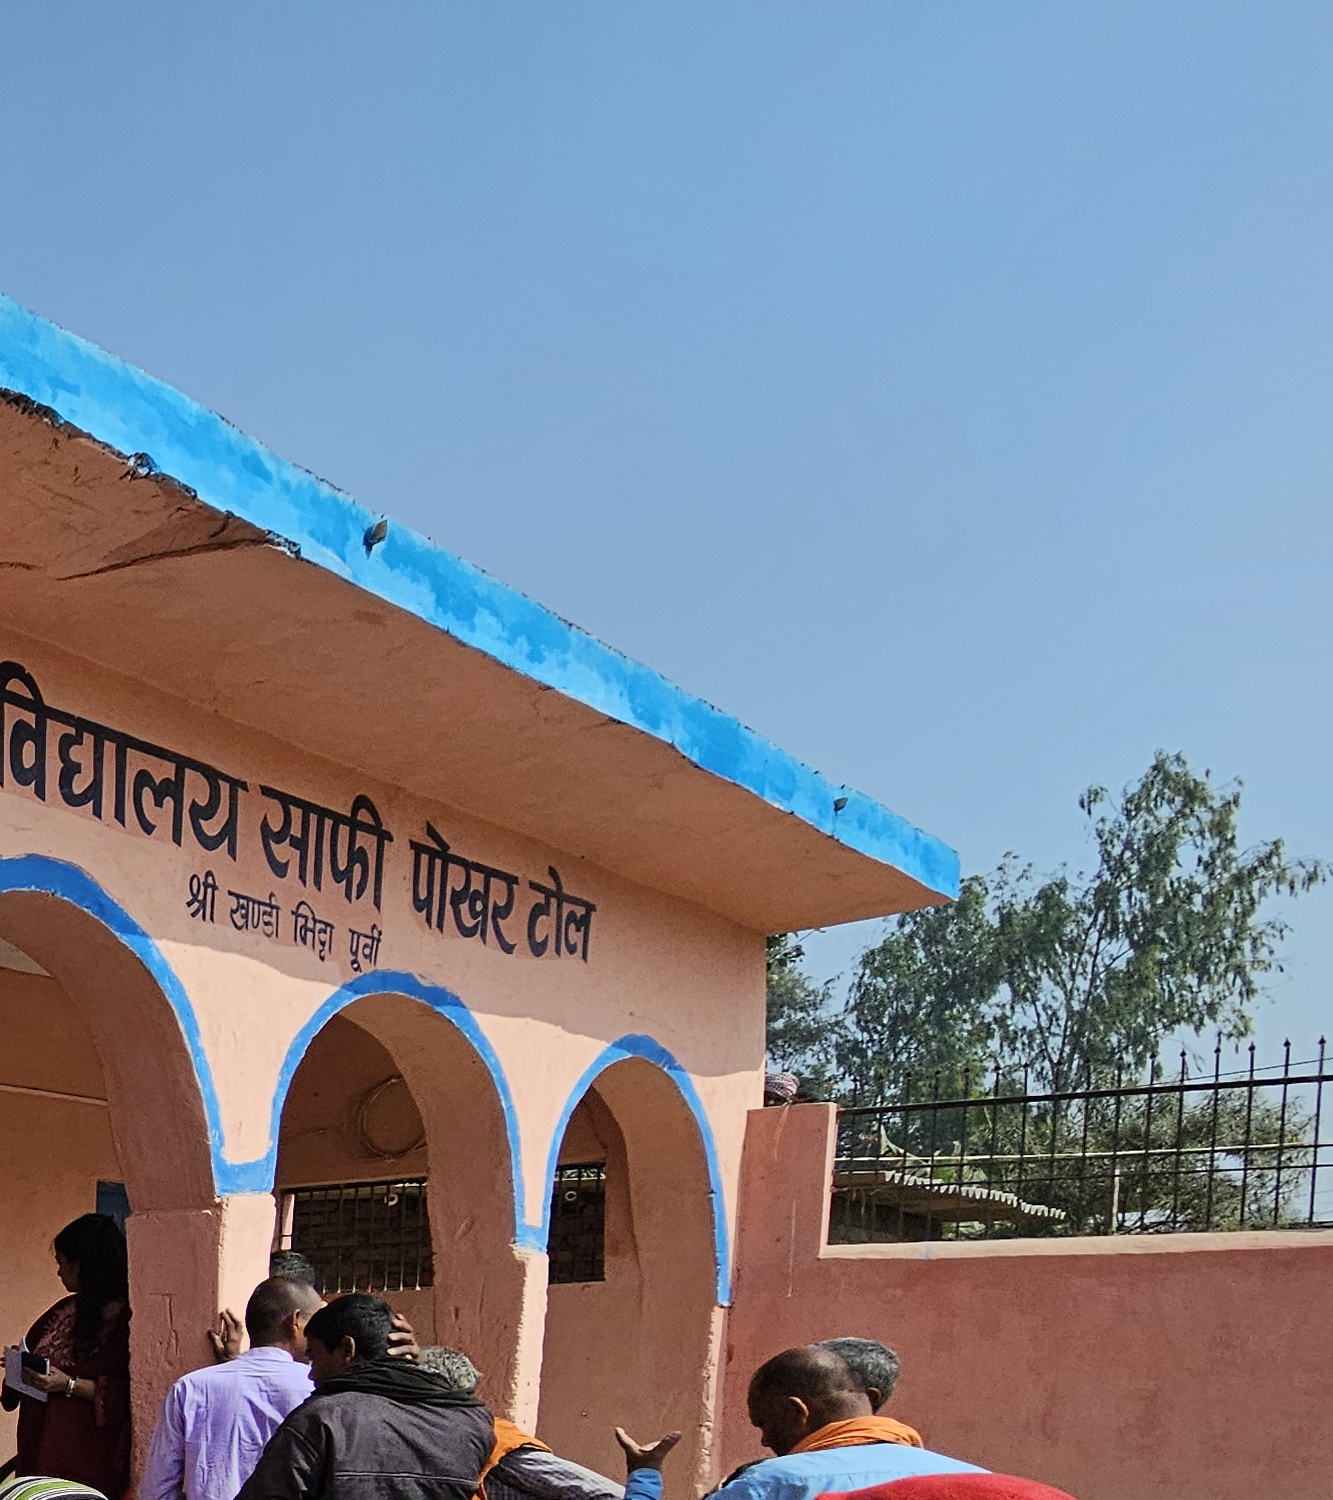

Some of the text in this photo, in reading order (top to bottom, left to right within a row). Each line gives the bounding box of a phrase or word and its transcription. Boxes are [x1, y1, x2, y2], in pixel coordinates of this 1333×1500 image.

[186, 870, 219, 924] श्री
[228, 891, 281, 939] खण्डी
[260, 785, 394, 912] साफी
[409, 821, 519, 954] पोखर
[527, 865, 596, 963] टोल
